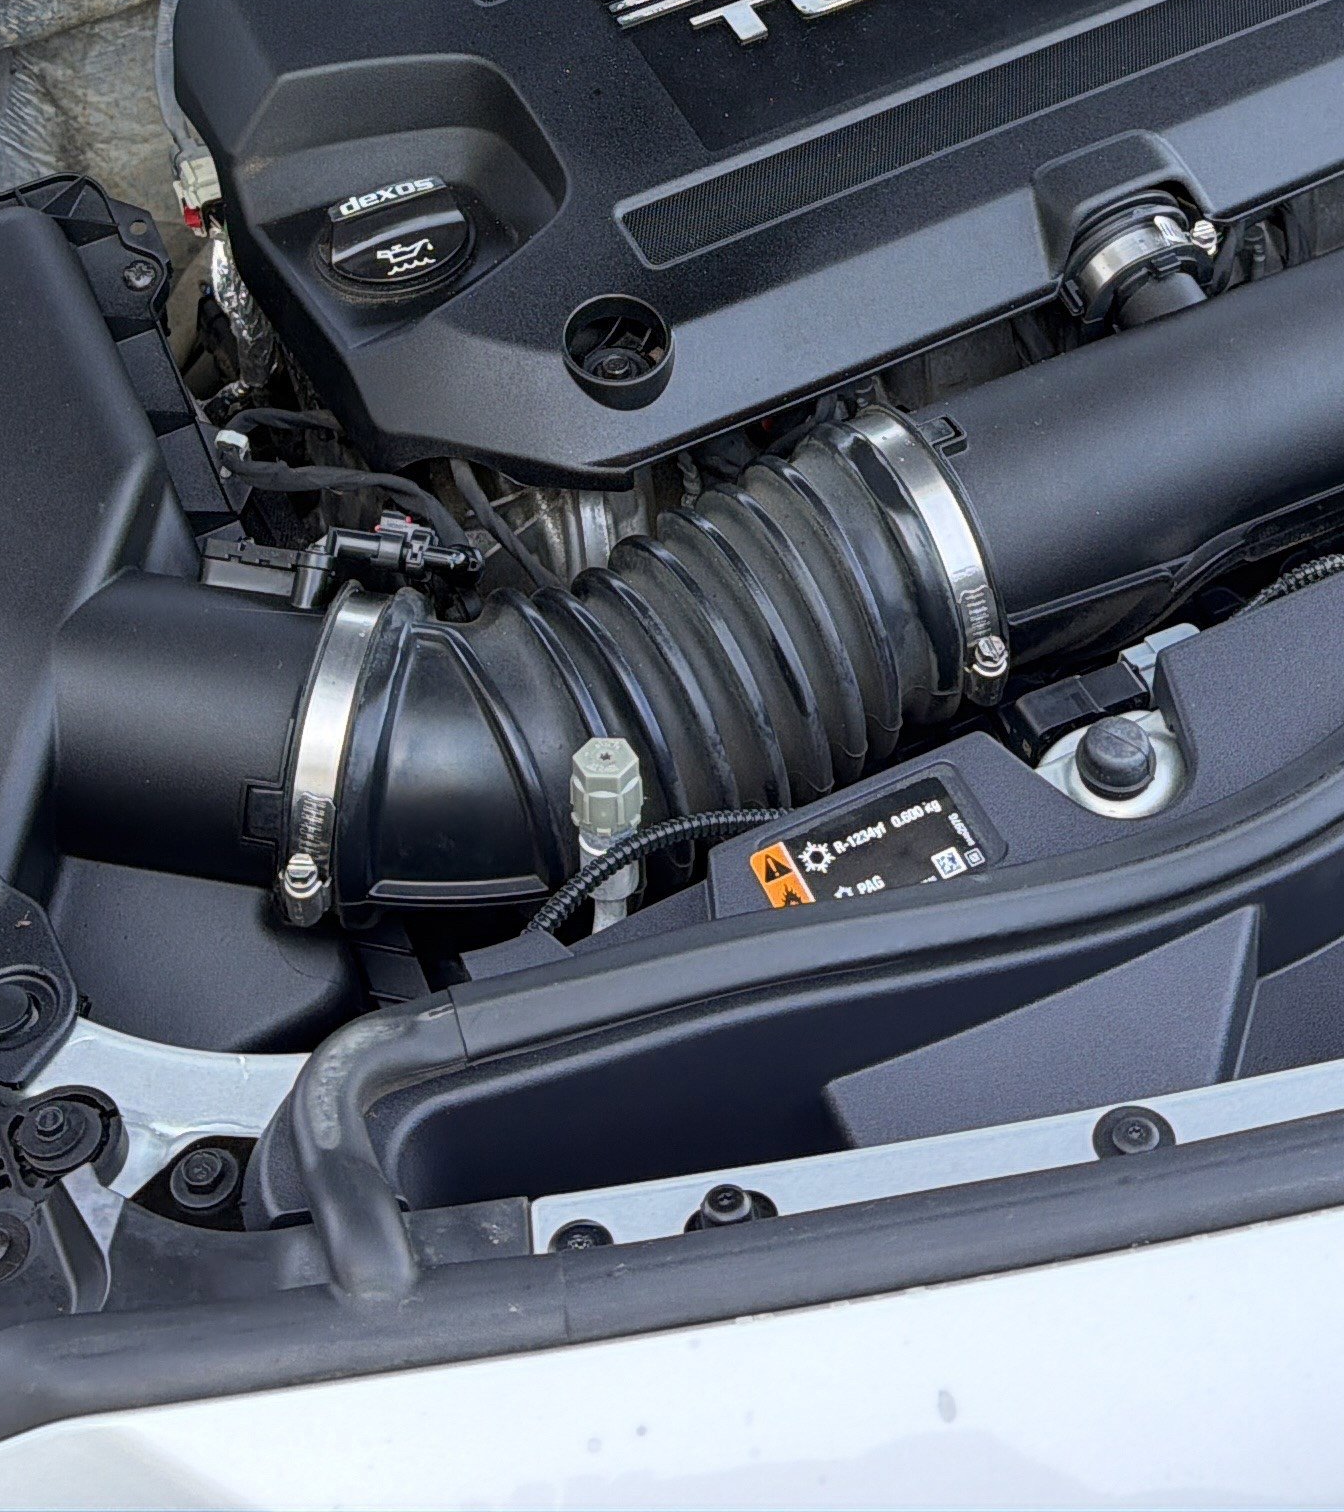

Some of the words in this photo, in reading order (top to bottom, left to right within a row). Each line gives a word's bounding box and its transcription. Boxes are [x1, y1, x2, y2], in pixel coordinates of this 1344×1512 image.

[339, 177, 434, 216] dexos
[833, 821, 887, 854] R-1234yf
[922, 799, 942, 814] kg
[856, 875, 886, 895] PAG
